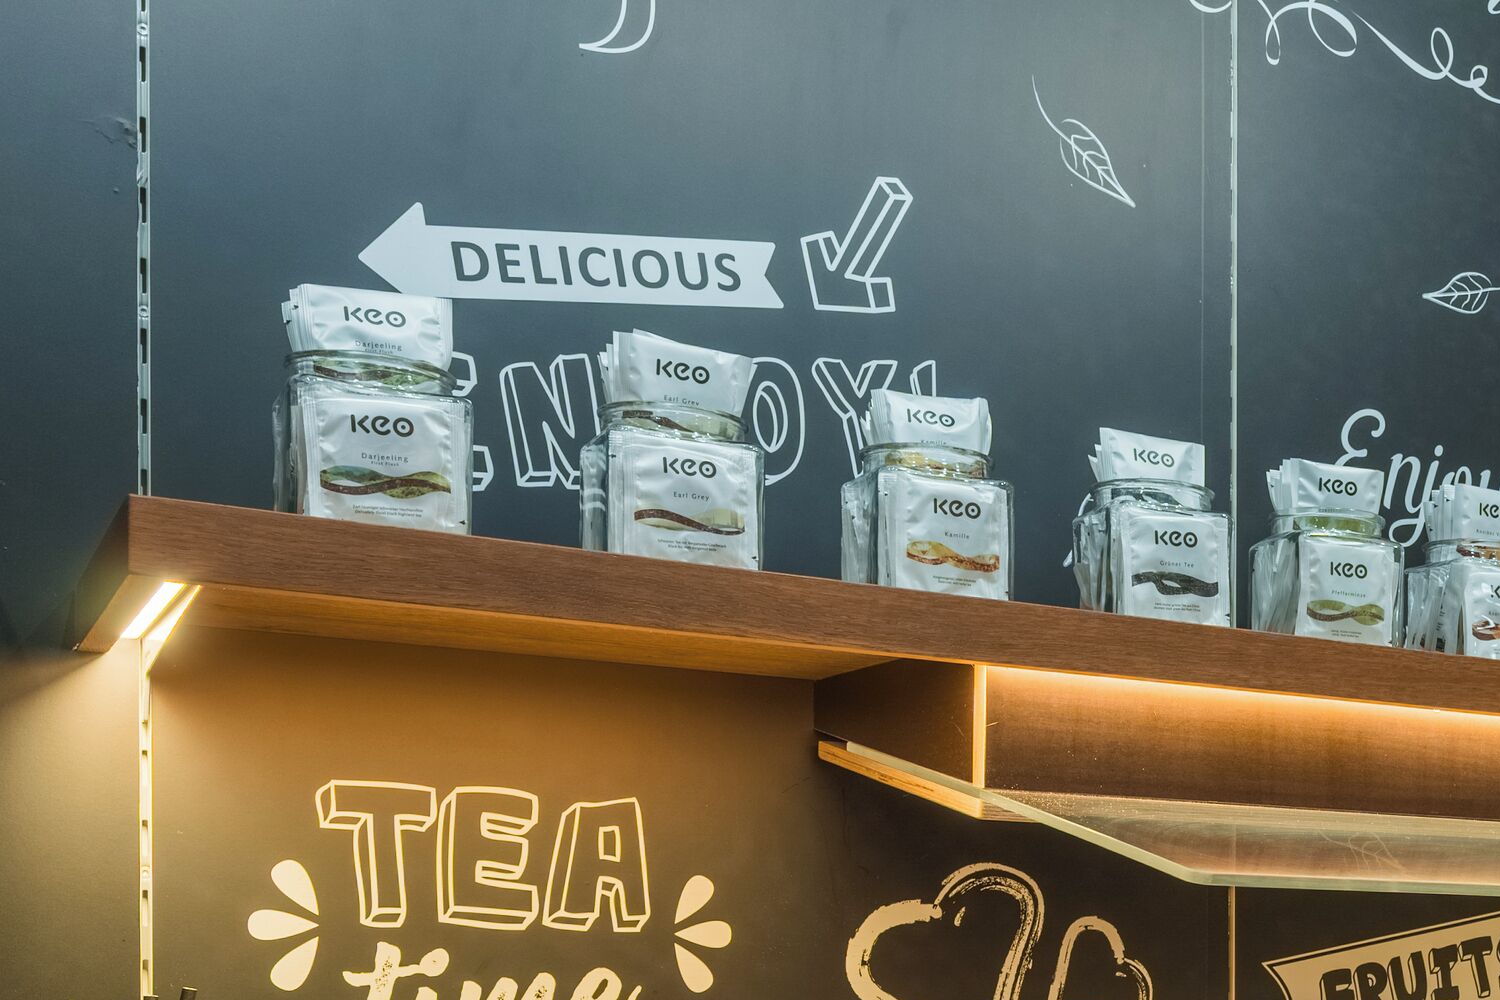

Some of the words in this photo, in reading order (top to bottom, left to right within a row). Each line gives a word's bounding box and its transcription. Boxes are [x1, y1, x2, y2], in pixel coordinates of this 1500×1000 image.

[451, 240, 742, 292] DELICIOUS
[355, 340, 402, 351] Darjeeling
[663, 394, 679, 403] Earl
[361, 452, 409, 463] Darjeeling
[673, 491, 689, 500] Earl
[691, 493, 710, 502] Grey
[944, 531, 970, 540] Kamille
[1184, 561, 1195, 569] Tee
[315, 778, 651, 932] TEA
